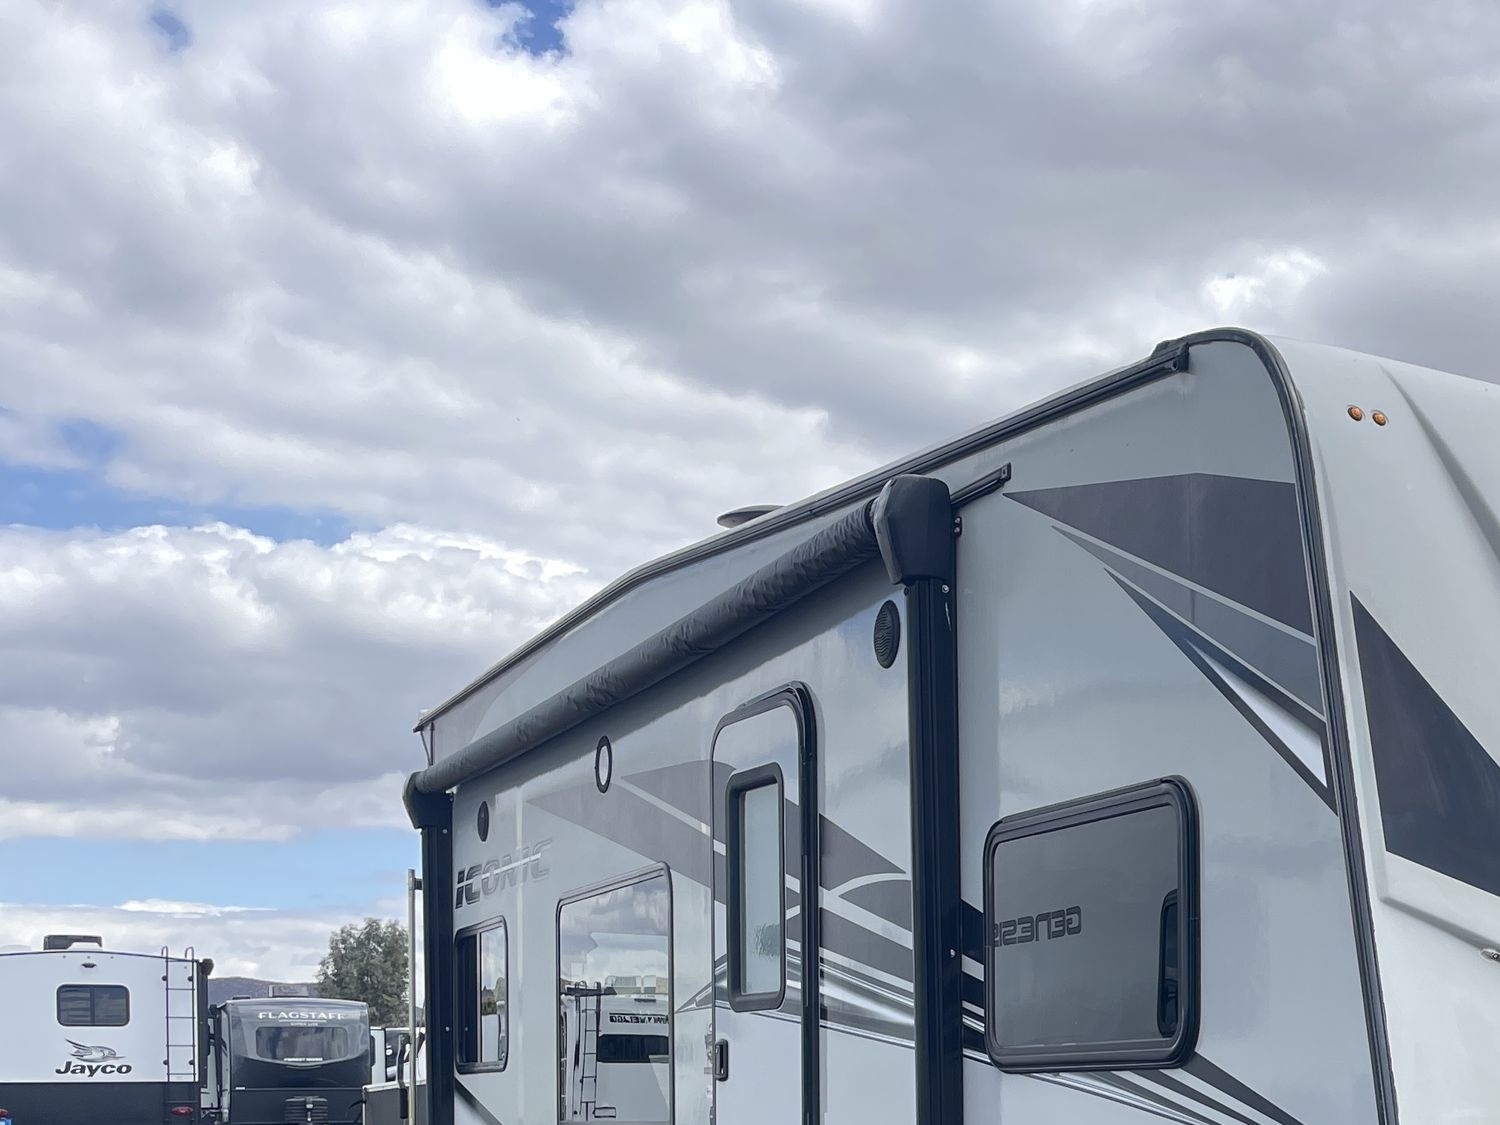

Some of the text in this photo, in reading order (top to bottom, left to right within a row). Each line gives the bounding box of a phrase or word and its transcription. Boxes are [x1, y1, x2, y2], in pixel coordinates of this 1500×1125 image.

[455, 838, 553, 909] ICONIC
[258, 1011, 345, 1020] FLAGSTAFF
[55, 1061, 132, 1077] Jayco
